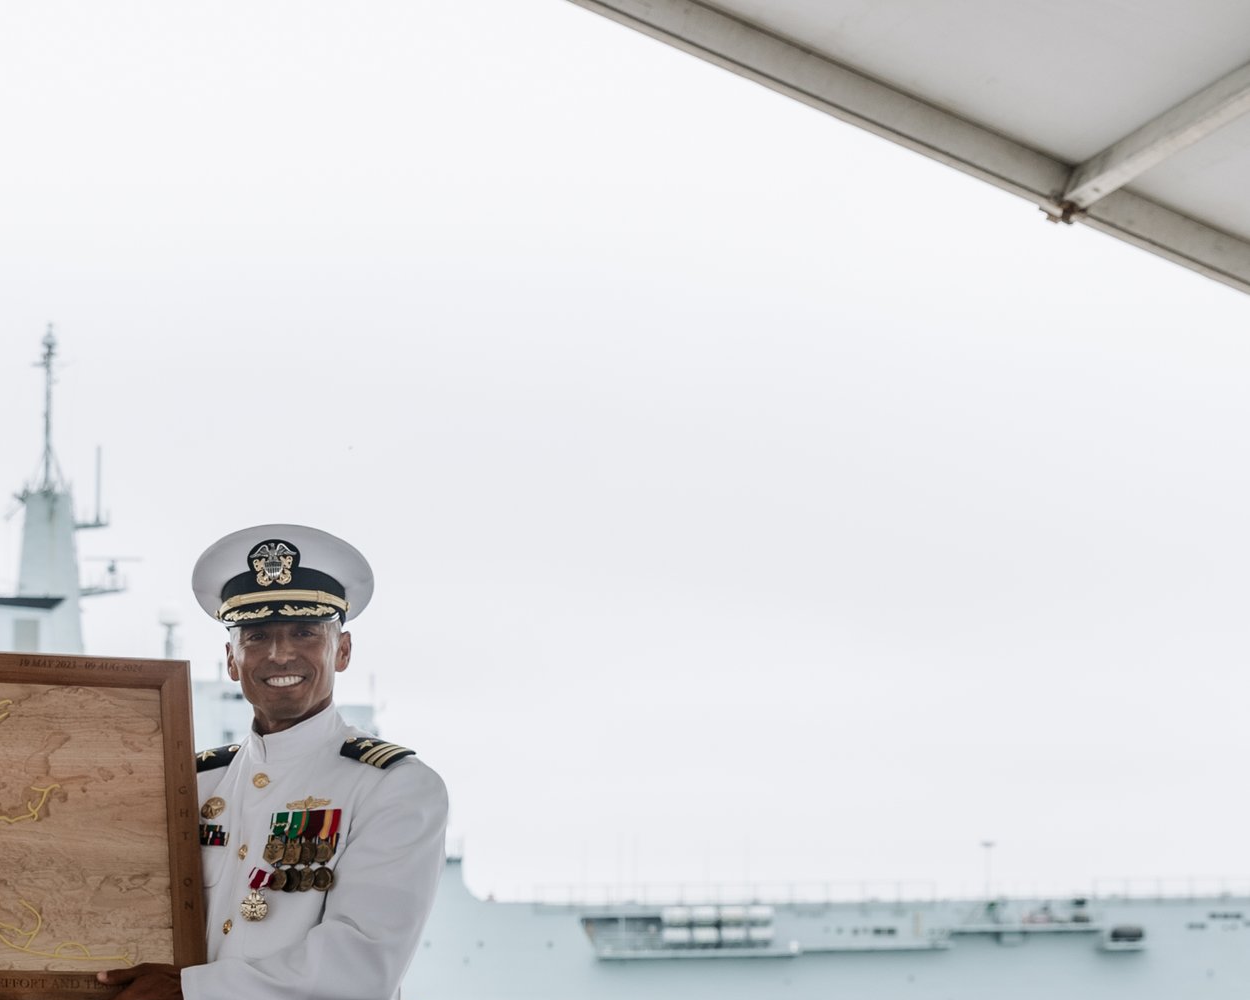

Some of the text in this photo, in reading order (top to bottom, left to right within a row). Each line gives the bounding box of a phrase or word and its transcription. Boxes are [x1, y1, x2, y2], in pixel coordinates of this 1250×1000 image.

[97, 662, 119, 672] AUG
[177, 741, 194, 910] FIGHT ON
[52, 978, 80, 990] AND
